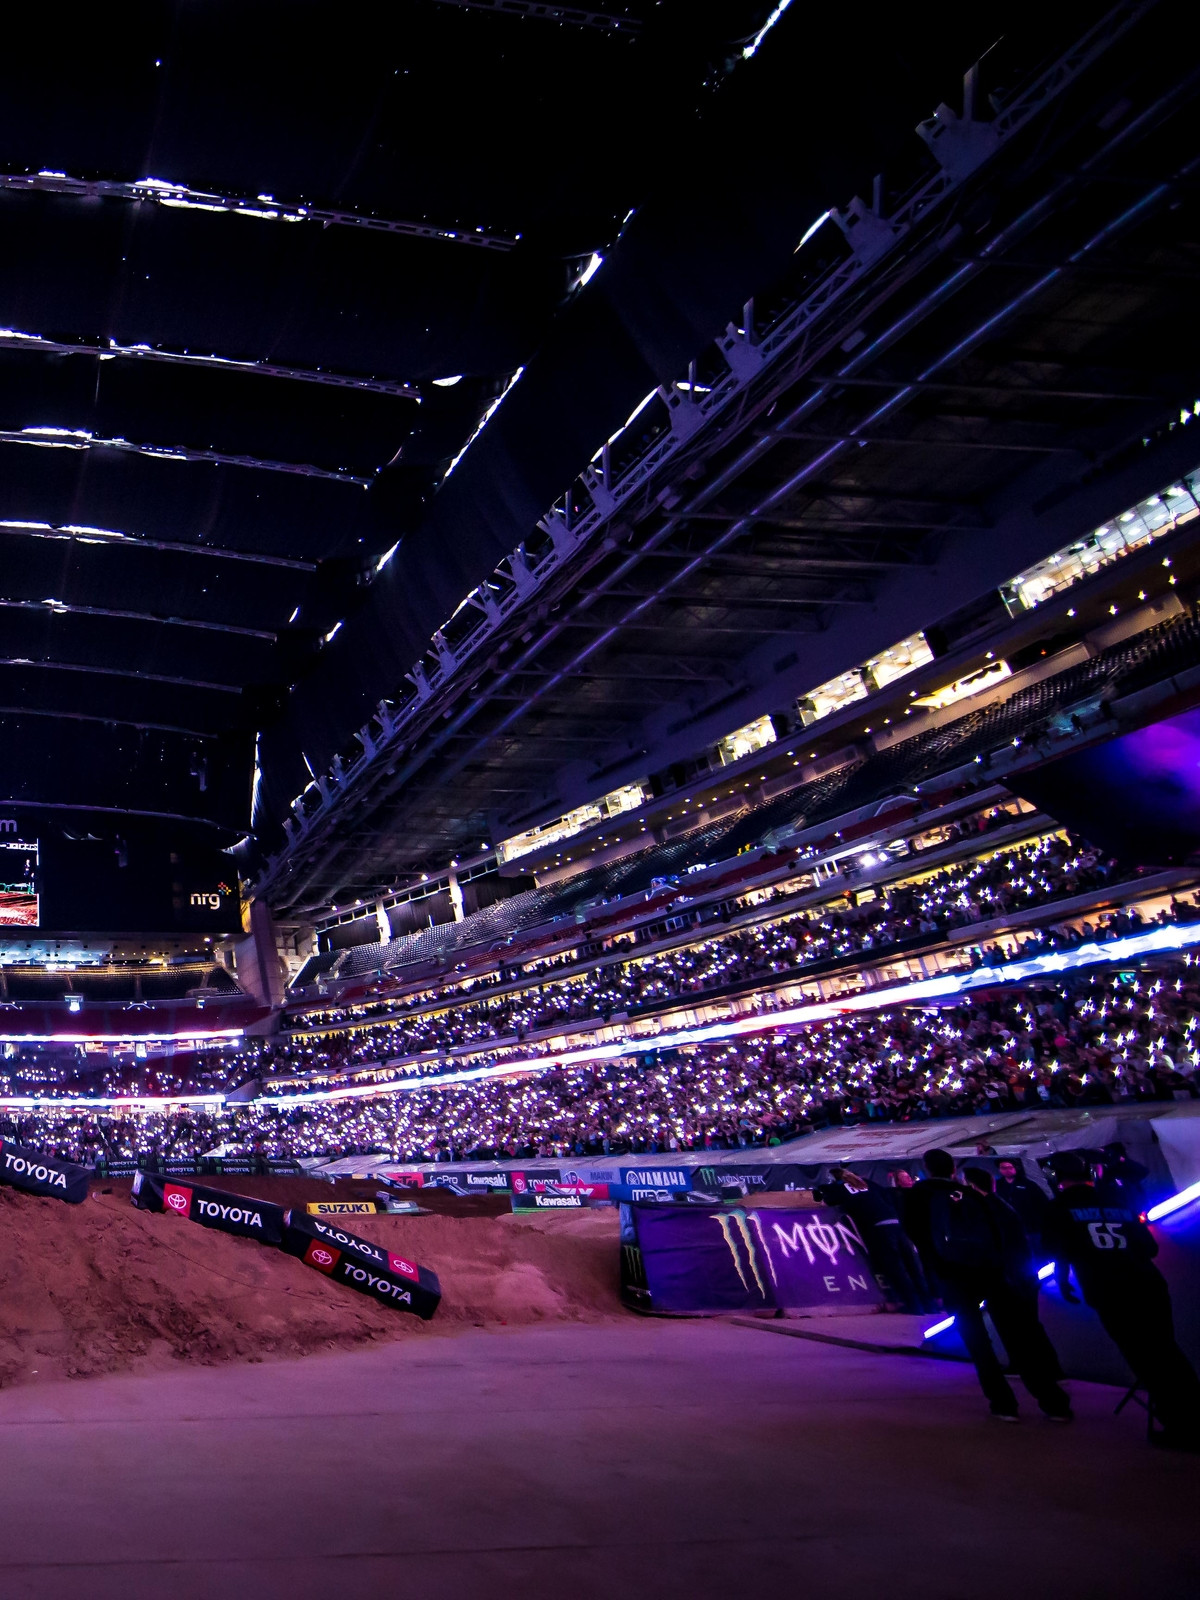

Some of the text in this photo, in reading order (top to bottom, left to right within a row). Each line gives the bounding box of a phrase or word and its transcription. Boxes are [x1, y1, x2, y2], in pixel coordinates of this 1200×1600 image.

[190, 893, 220, 910] nrg
[5, 1153, 67, 1188] TOYOTA
[639, 1171, 686, 1186] YAMAHA
[467, 1173, 507, 1187] Kawasaki
[717, 1174, 766, 1185] MONSTER
[318, 1203, 369, 1213] SUZUKI
[536, 1195, 581, 1206] Kawasaki
[197, 1199, 262, 1228] TOYOTA
[314, 1221, 383, 1261] TOYOTA
[1087, 1222, 1127, 1248] 65
[344, 1262, 412, 1305] TOYOTA
